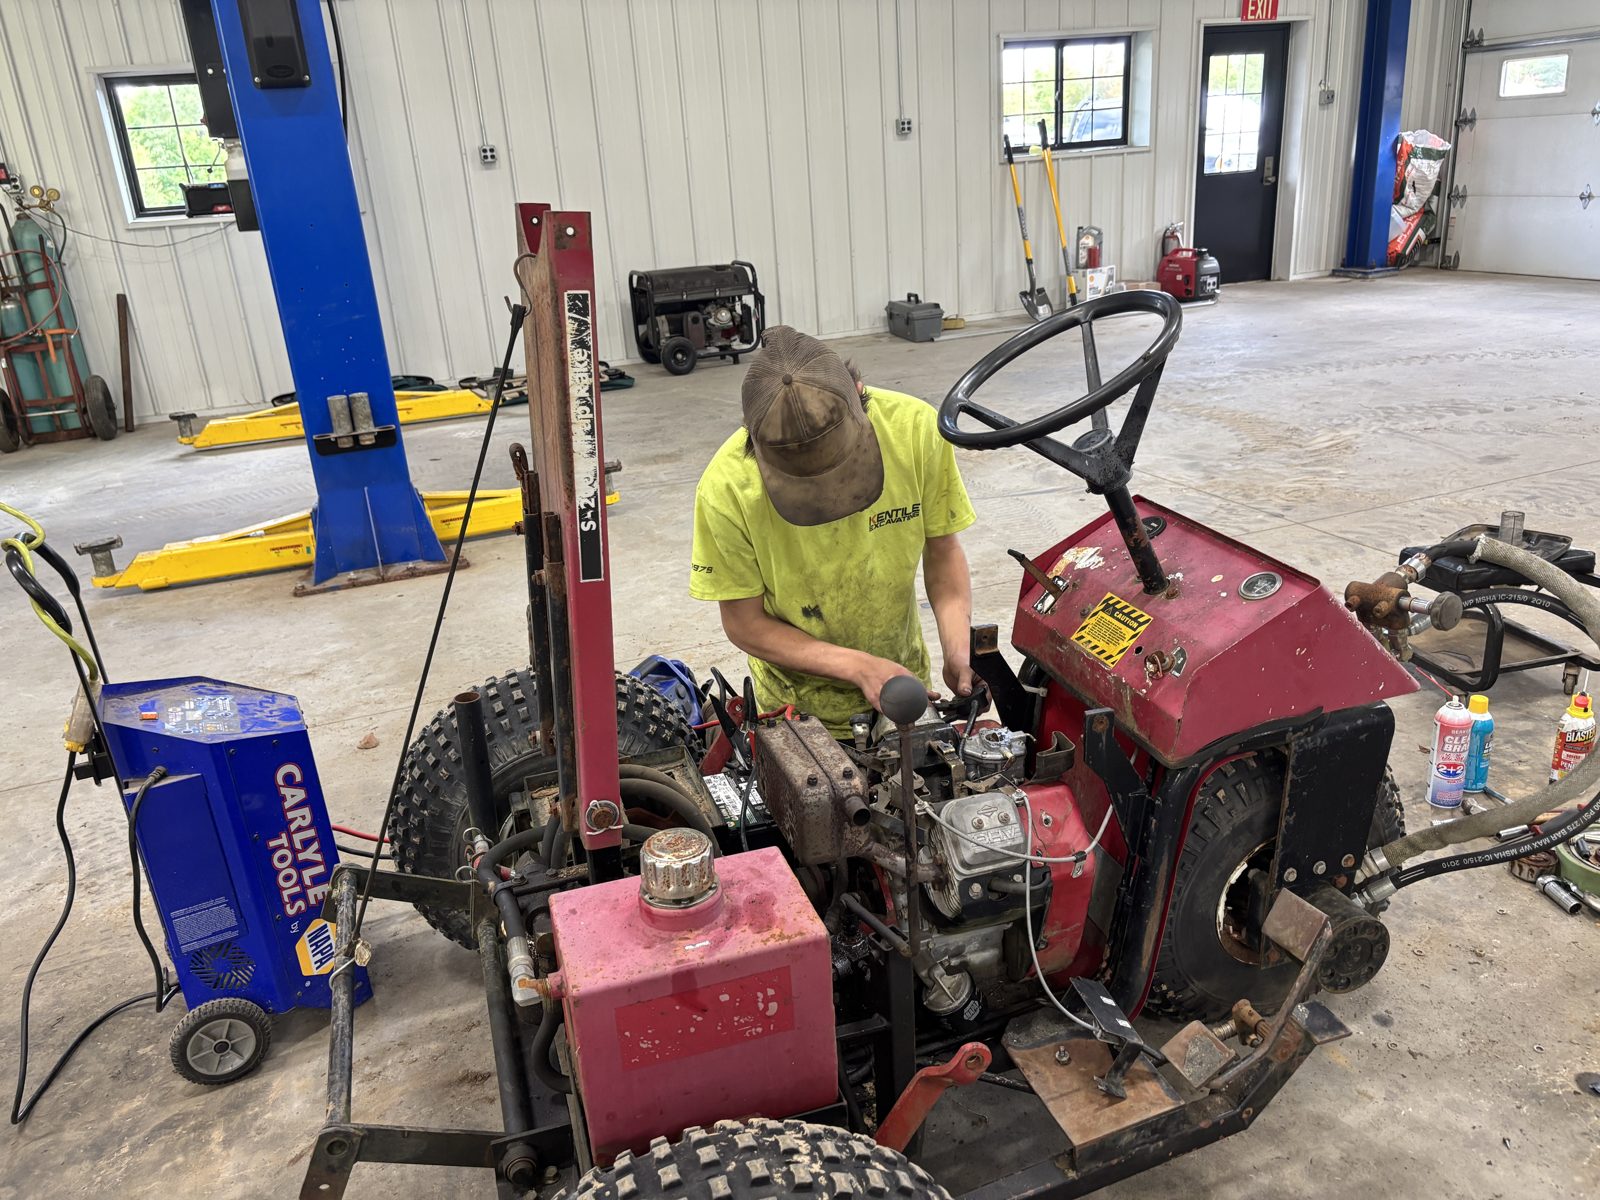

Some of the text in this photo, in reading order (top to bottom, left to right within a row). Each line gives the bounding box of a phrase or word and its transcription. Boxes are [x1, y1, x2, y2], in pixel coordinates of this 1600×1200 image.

[1247, 0, 1272, 19] EXIT
[869, 503, 921, 528] KENTILE
[869, 511, 920, 532] EXCAVATING
[692, 563, 713, 574] 979
[1462, 600, 1474, 608] WP
[1475, 595, 1497, 604] MSHA
[1498, 593, 1528, 602] IC-215/0
[1113, 611, 1139, 629] CAUTION
[1437, 765, 1464, 774] 2+2
[1583, 809, 1596, 821] PSI
[1566, 820, 1581, 832] 275
[275, 763, 330, 905] CARLYLE
[1550, 828, 1568, 841] BAR
[1532, 837, 1551, 847] MAX
[1494, 847, 1518, 859] MSHA
[1519, 844, 1533, 853] WP
[1463, 854, 1493, 865] IC-215/0
[267, 832, 307, 917] TOOLS
[290, 922, 300, 934] by
[307, 923, 335, 971] NAPA
